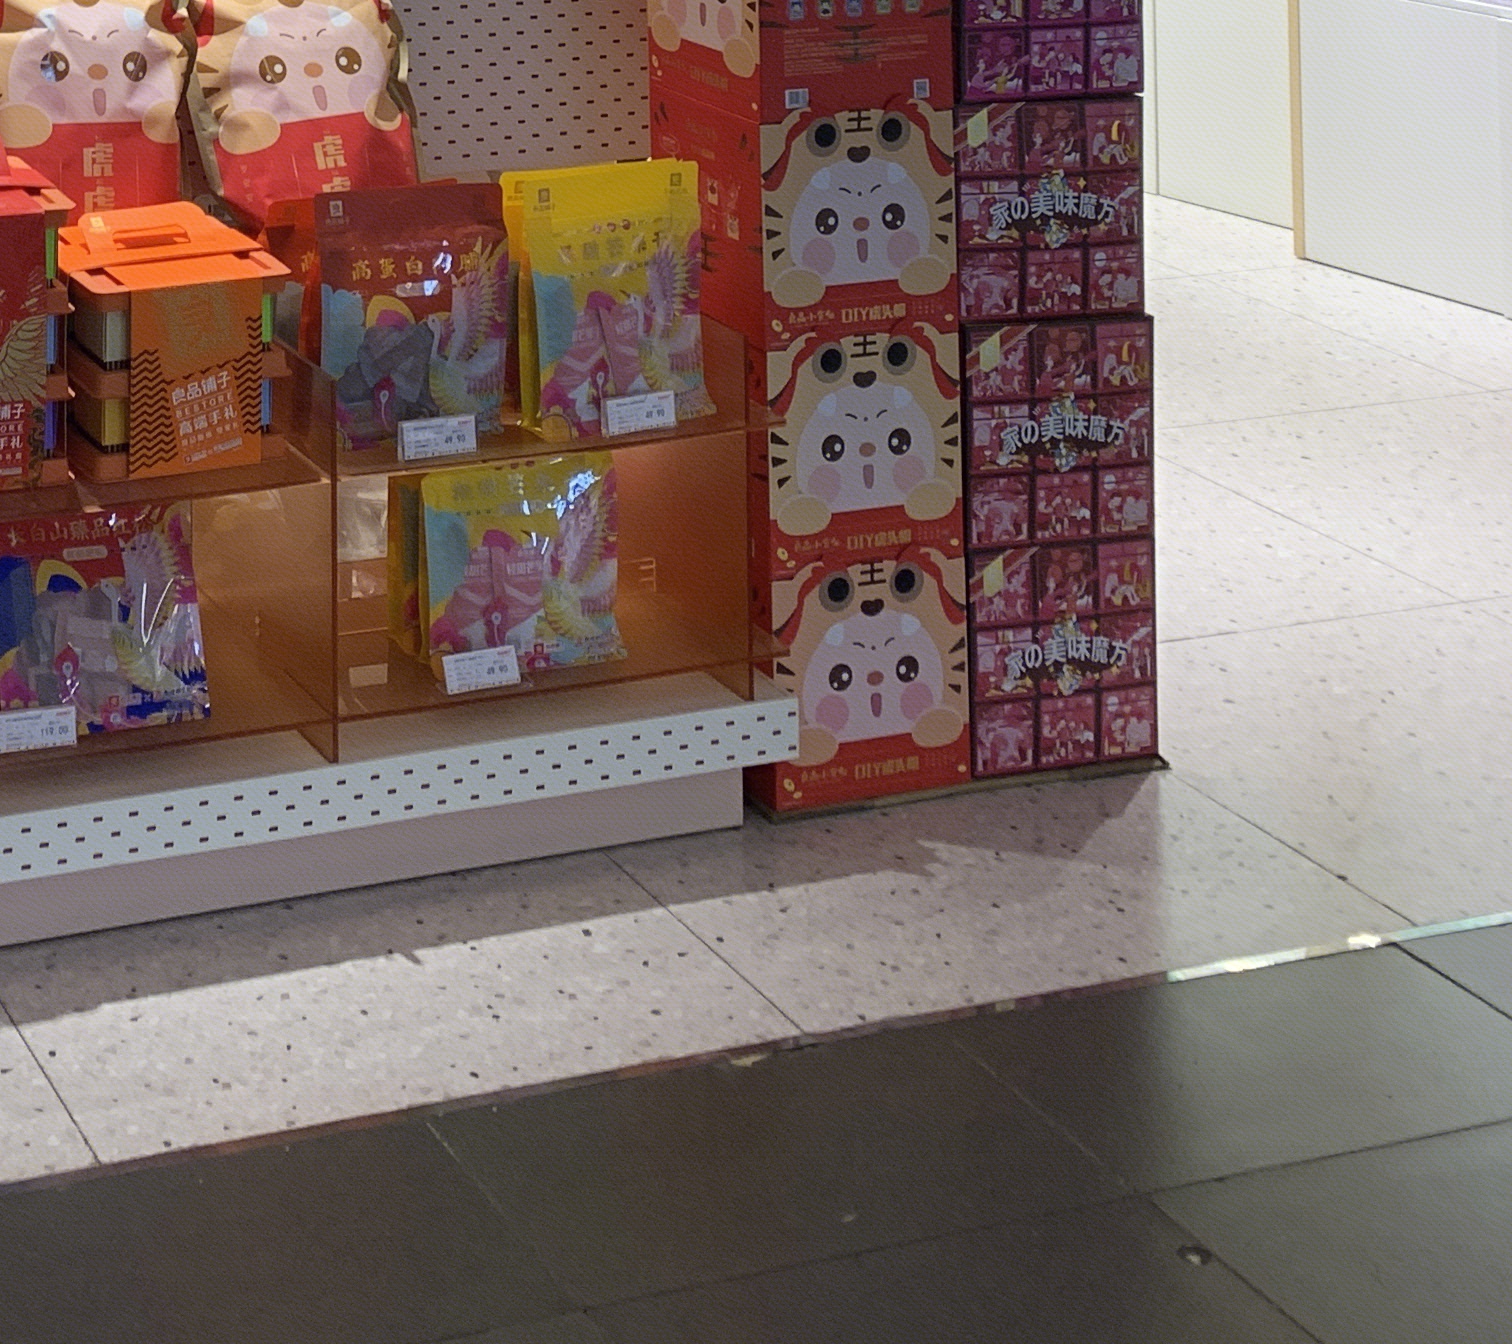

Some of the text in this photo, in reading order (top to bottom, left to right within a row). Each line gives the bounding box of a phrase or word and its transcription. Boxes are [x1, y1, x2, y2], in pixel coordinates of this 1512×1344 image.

[990, 189, 1117, 230] 家の美味魔方
[172, 370, 232, 406] 良品铺子
[176, 391, 235, 419] BESTORE
[178, 405, 238, 437] 高端手礼
[1001, 414, 1130, 454] 家の美味魔方
[1004, 638, 1129, 679] 家の美味魔方
